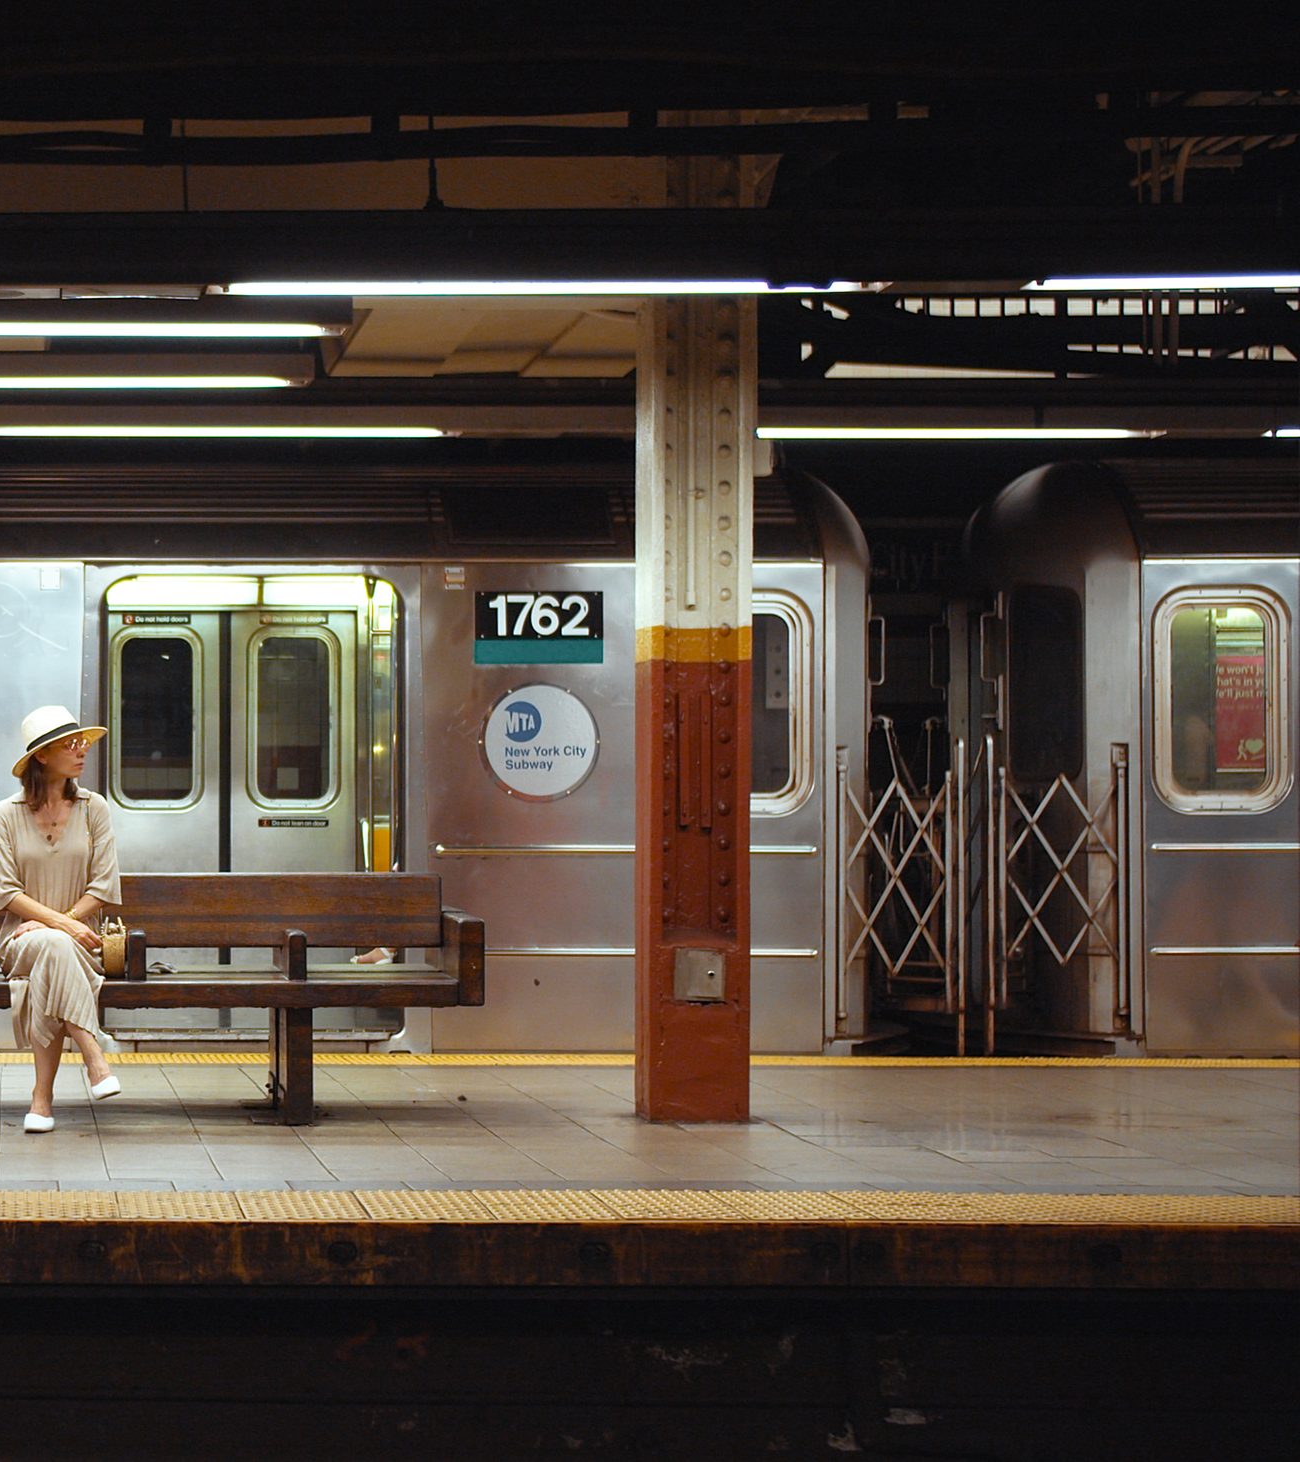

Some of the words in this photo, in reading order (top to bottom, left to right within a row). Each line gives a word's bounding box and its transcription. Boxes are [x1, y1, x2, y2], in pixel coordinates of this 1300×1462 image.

[135, 615, 145, 623] Do
[489, 594, 589, 637] 1762
[1226, 663, 1254, 675] won't
[1216, 675, 1242, 687] hat's
[1243, 675, 1253, 687] in
[1234, 688, 1254, 701] just
[505, 711, 536, 735] MTA
[505, 746, 531, 757] New
[533, 745, 561, 757] York
[563, 745, 588, 759] City
[505, 759, 554, 772] Subway
